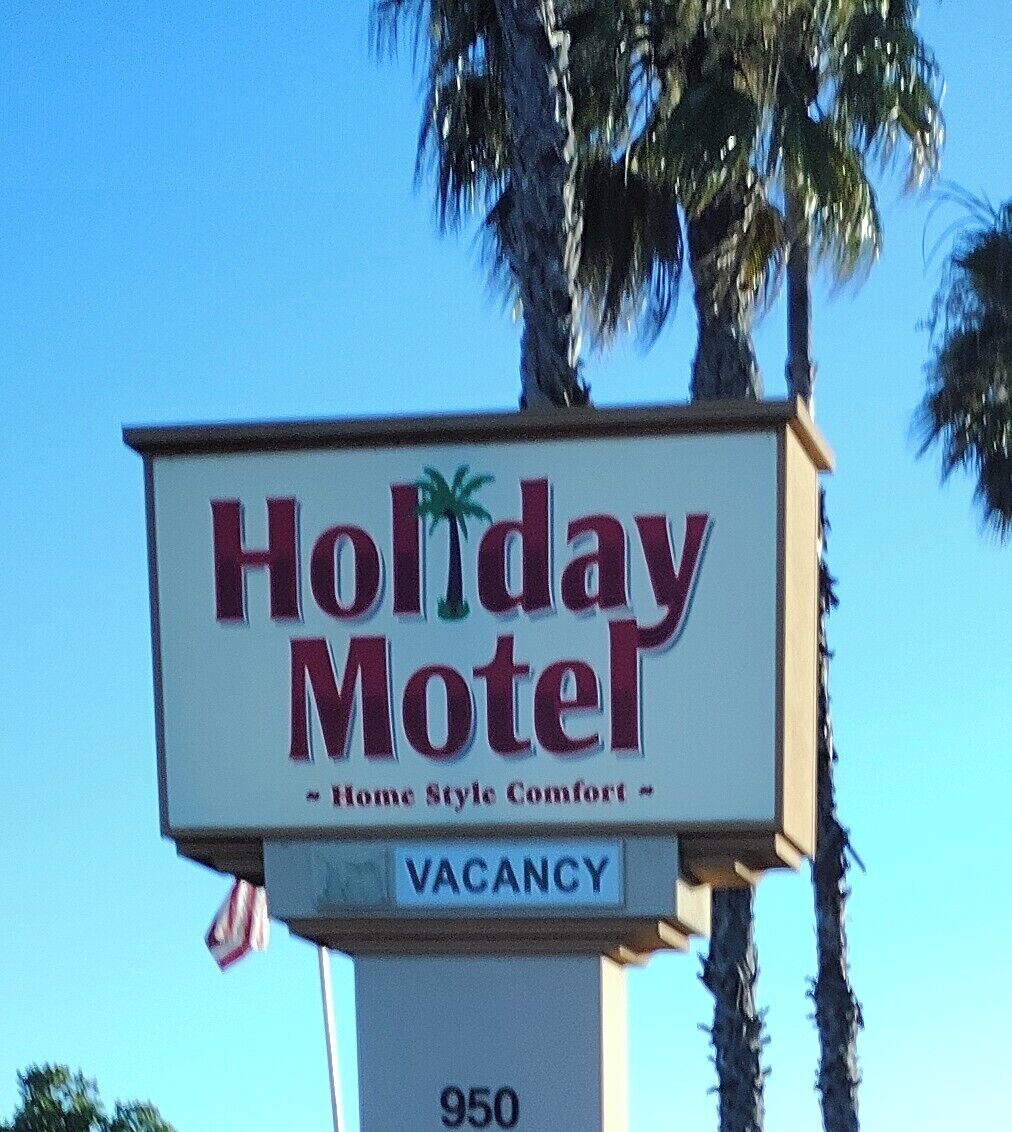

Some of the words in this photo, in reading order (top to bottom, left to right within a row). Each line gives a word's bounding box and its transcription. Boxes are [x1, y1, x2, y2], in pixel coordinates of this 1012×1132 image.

[210, 475, 716, 658] Holiday
[289, 618, 645, 764] Motel
[331, 783, 415, 808] Home
[426, 780, 496, 813] Style
[506, 779, 627, 806] Comfort
[405, 855, 609, 895] VACANCY
[440, 1085, 520, 1129] 950
